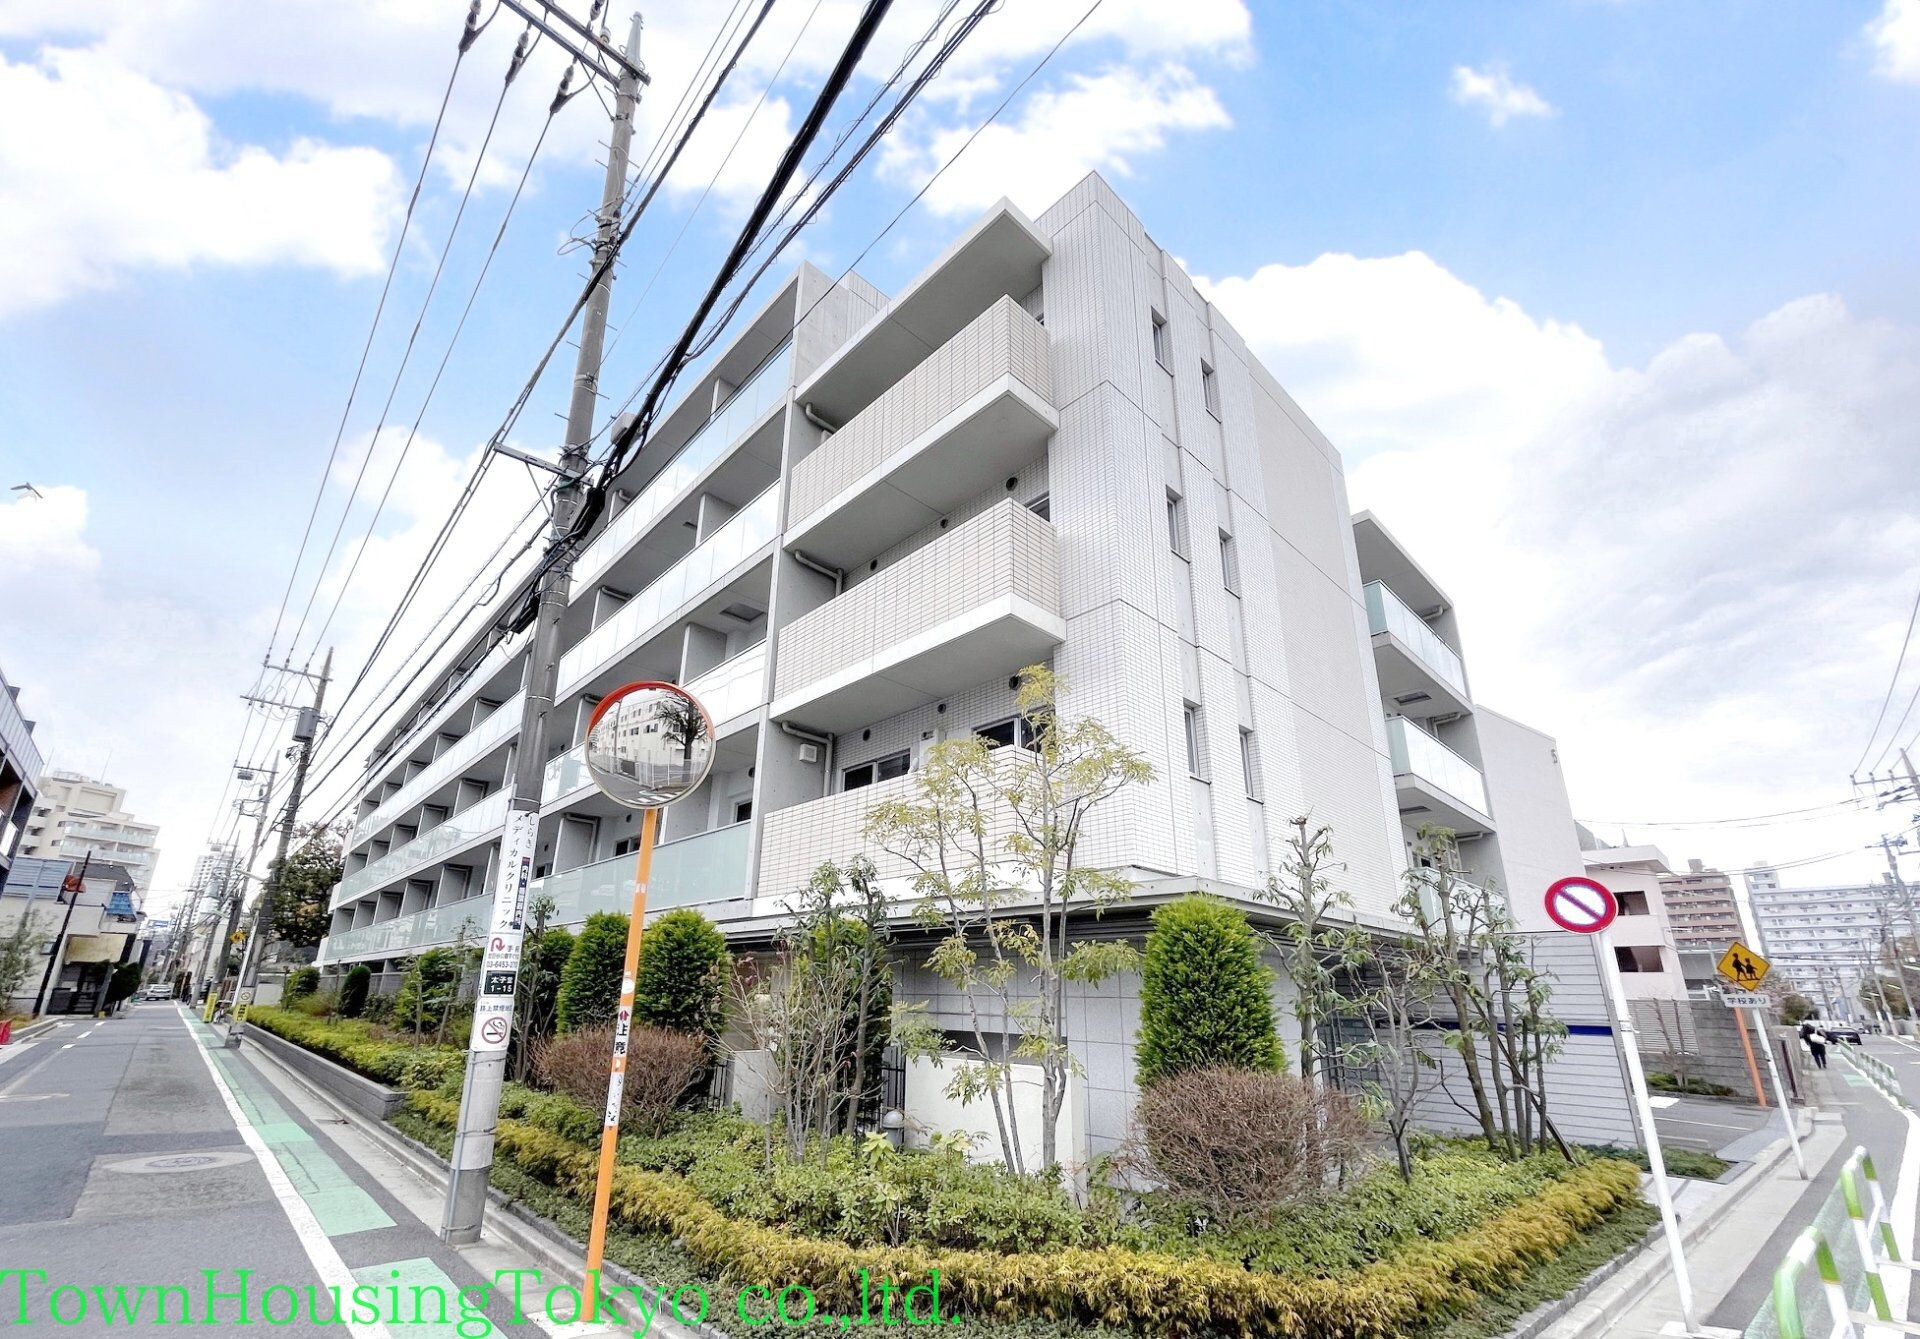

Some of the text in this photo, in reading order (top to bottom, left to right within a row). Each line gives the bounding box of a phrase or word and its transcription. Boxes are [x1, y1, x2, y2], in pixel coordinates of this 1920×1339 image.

[499, 815, 523, 929] メディカルクリニック
[491, 976, 514, 984] 太子堂
[490, 985, 512, 993] 1-15
[1727, 997, 1767, 1005] 学校あり
